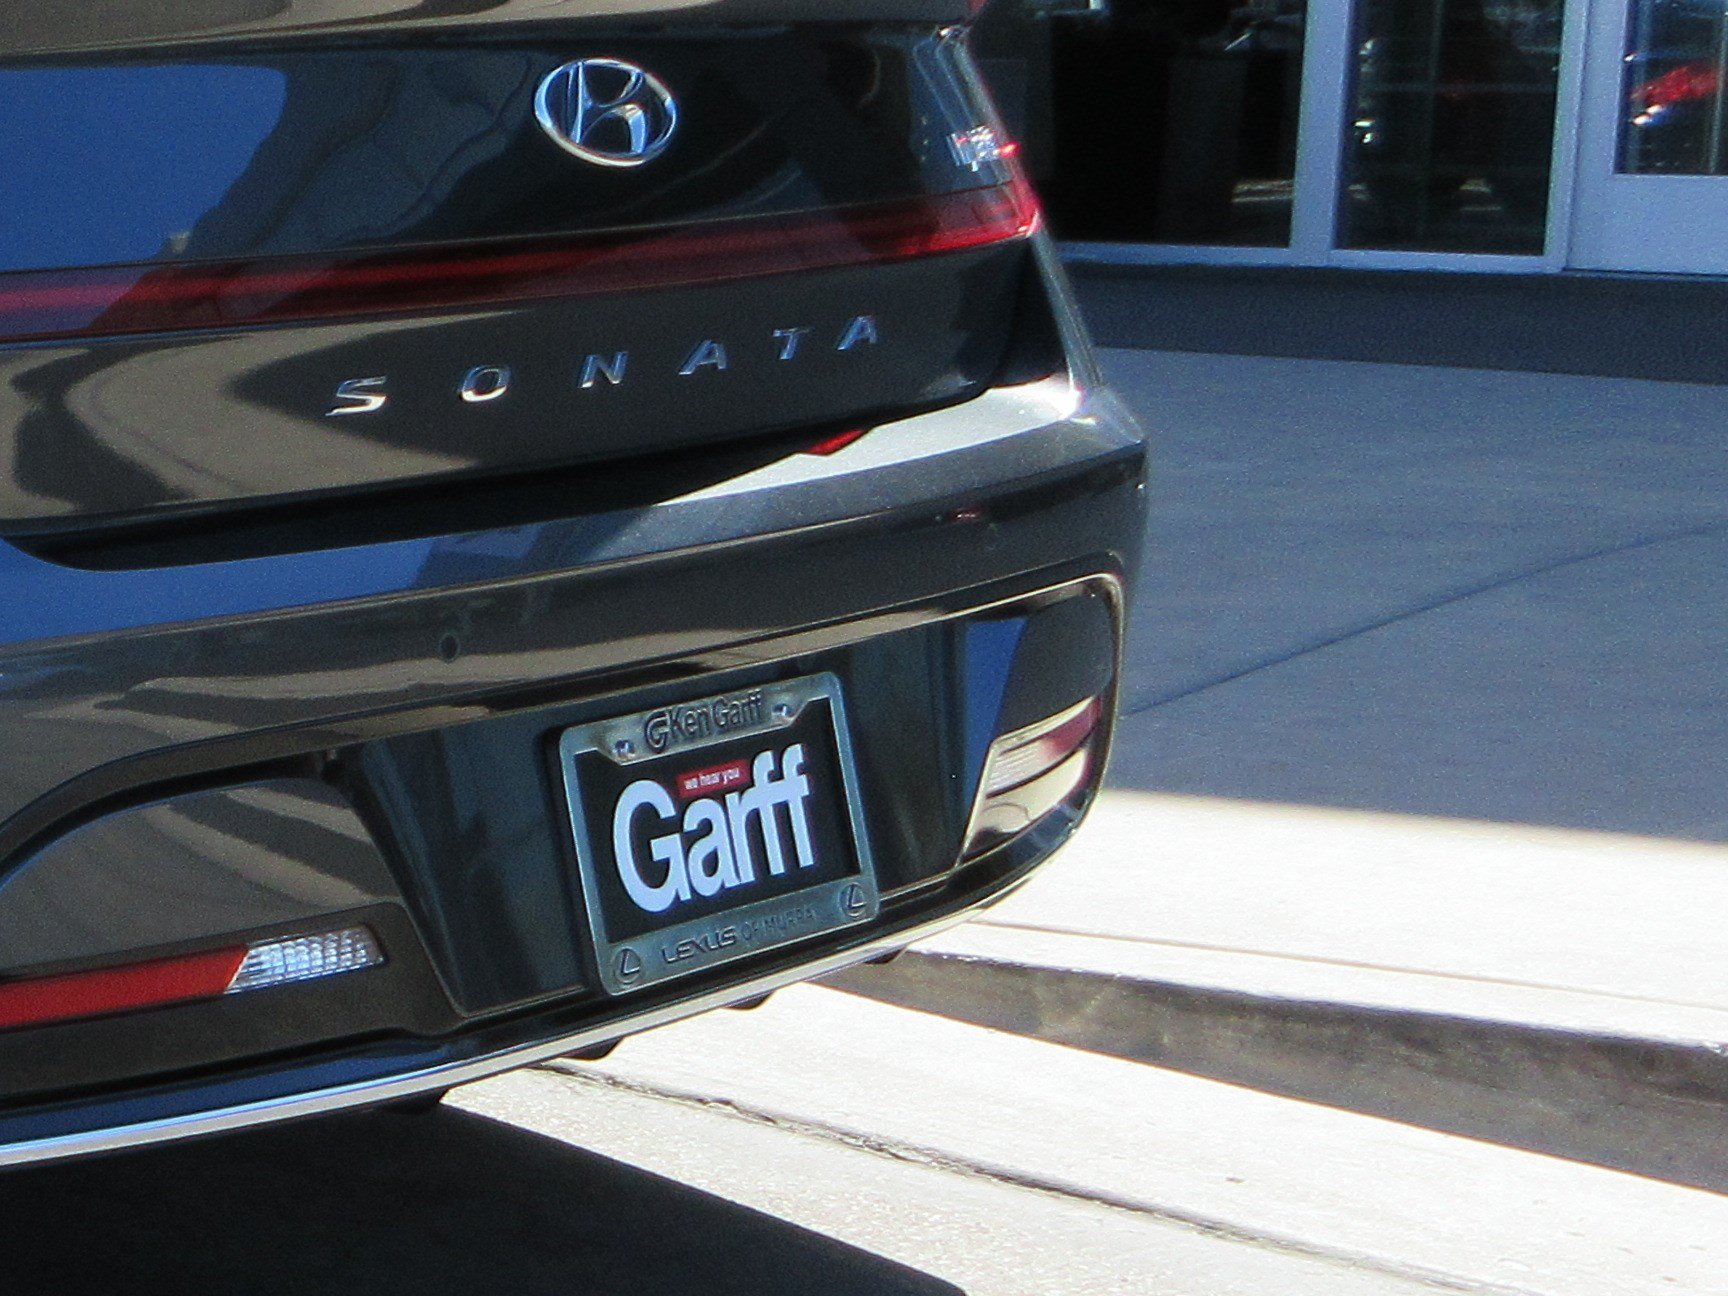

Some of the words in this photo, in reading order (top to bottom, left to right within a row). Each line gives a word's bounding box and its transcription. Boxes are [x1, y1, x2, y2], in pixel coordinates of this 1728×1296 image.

[325, 315, 879, 417] SONATA
[668, 707, 710, 739] Ken
[712, 690, 763, 728] Garff
[722, 766, 741, 786] you
[613, 743, 814, 912] Garff
[661, 925, 737, 964] LEXUS
